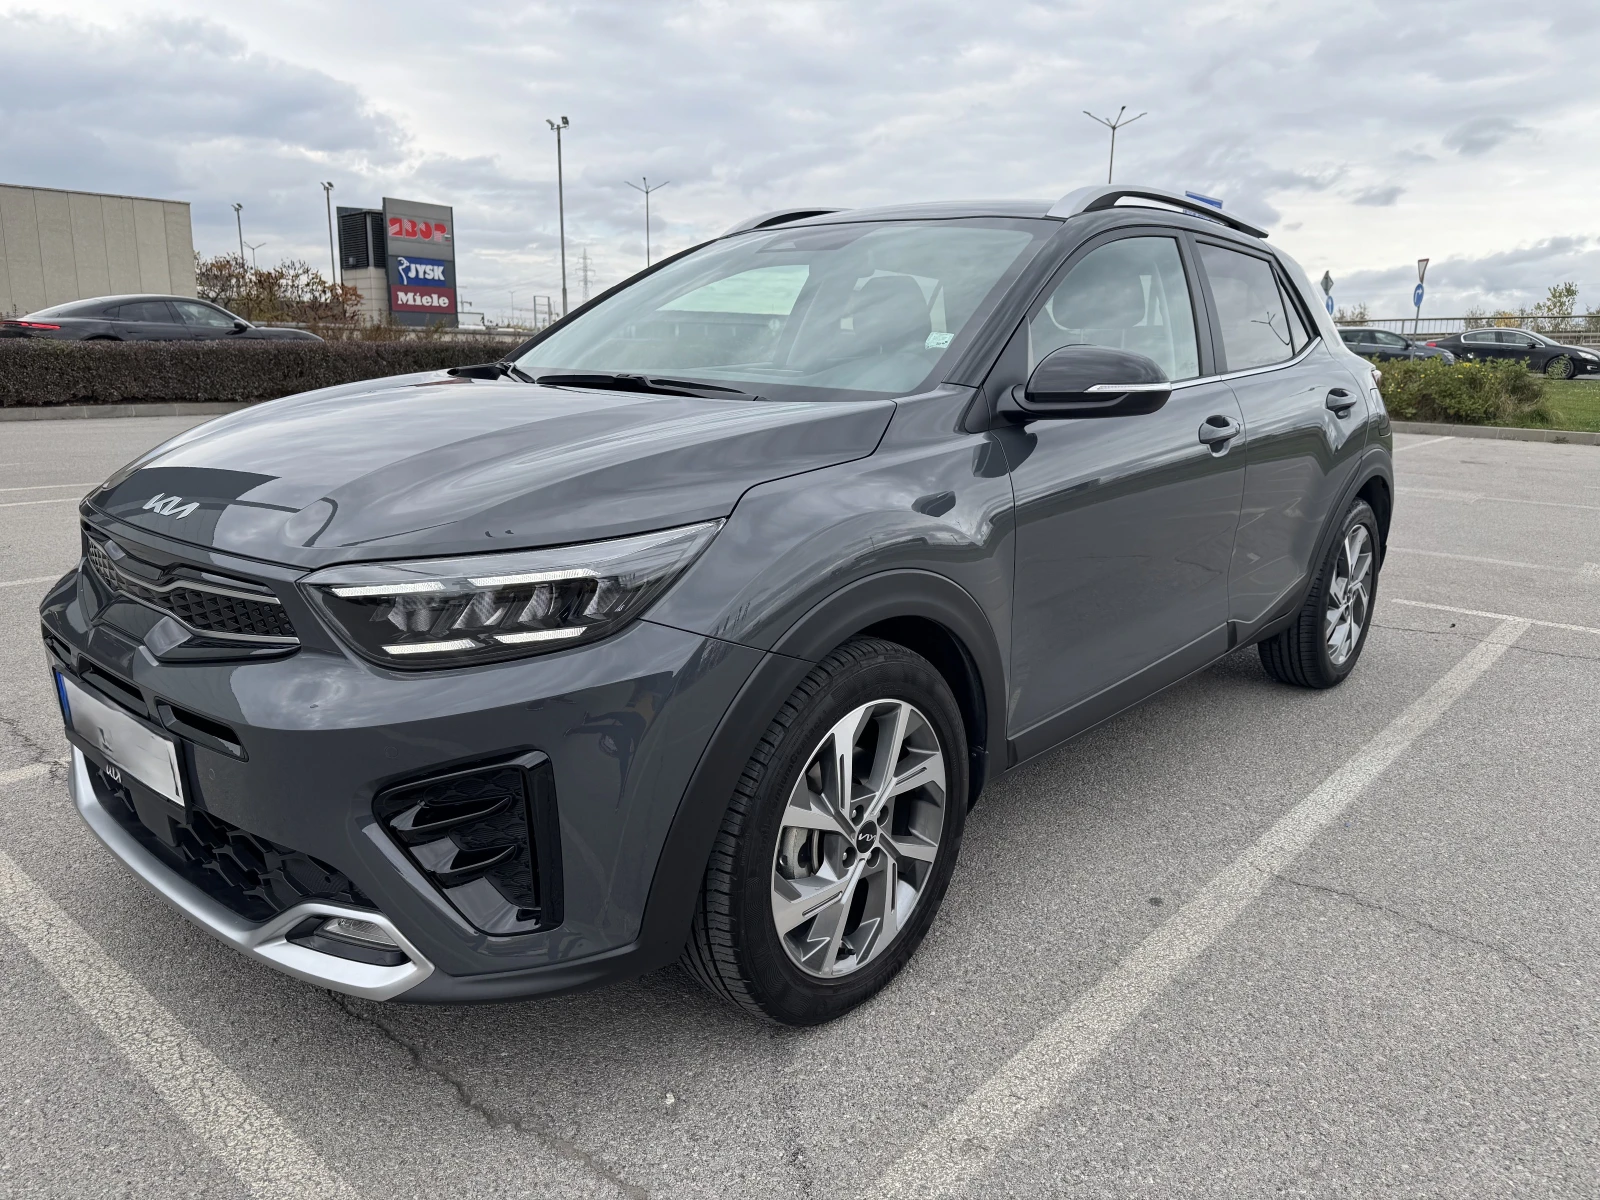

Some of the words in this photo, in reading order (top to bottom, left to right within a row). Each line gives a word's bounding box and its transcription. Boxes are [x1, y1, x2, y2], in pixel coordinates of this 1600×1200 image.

[408, 264, 445, 280] JYSK
[397, 291, 449, 307] Miele
[142, 492, 200, 520] KIA
